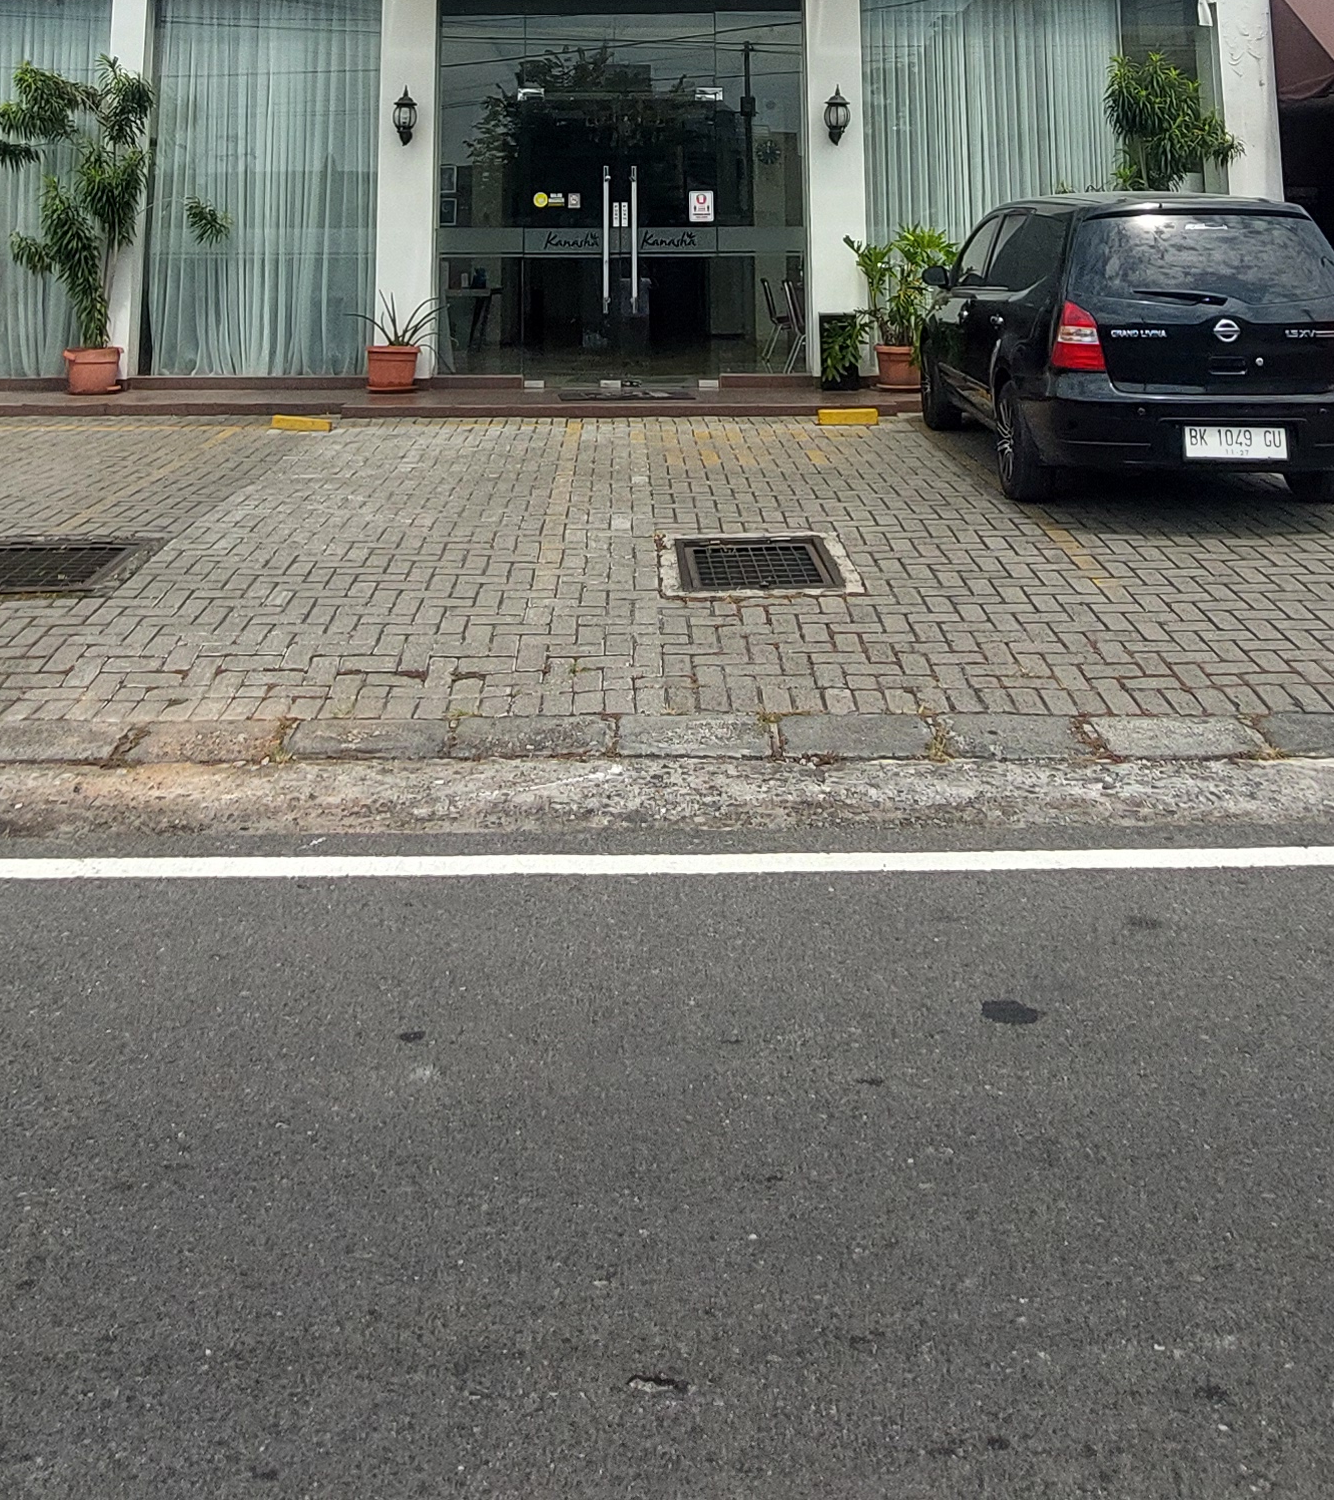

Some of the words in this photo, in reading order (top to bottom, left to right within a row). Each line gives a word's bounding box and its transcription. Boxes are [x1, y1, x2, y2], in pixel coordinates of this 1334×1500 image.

[544, 231, 599, 249] Kanasha
[641, 231, 697, 249] Kanasha
[1111, 329, 1139, 338] GRAND
[1189, 428, 1208, 446] BK
[1217, 429, 1253, 447] 1049
[1264, 430, 1282, 448] GU
